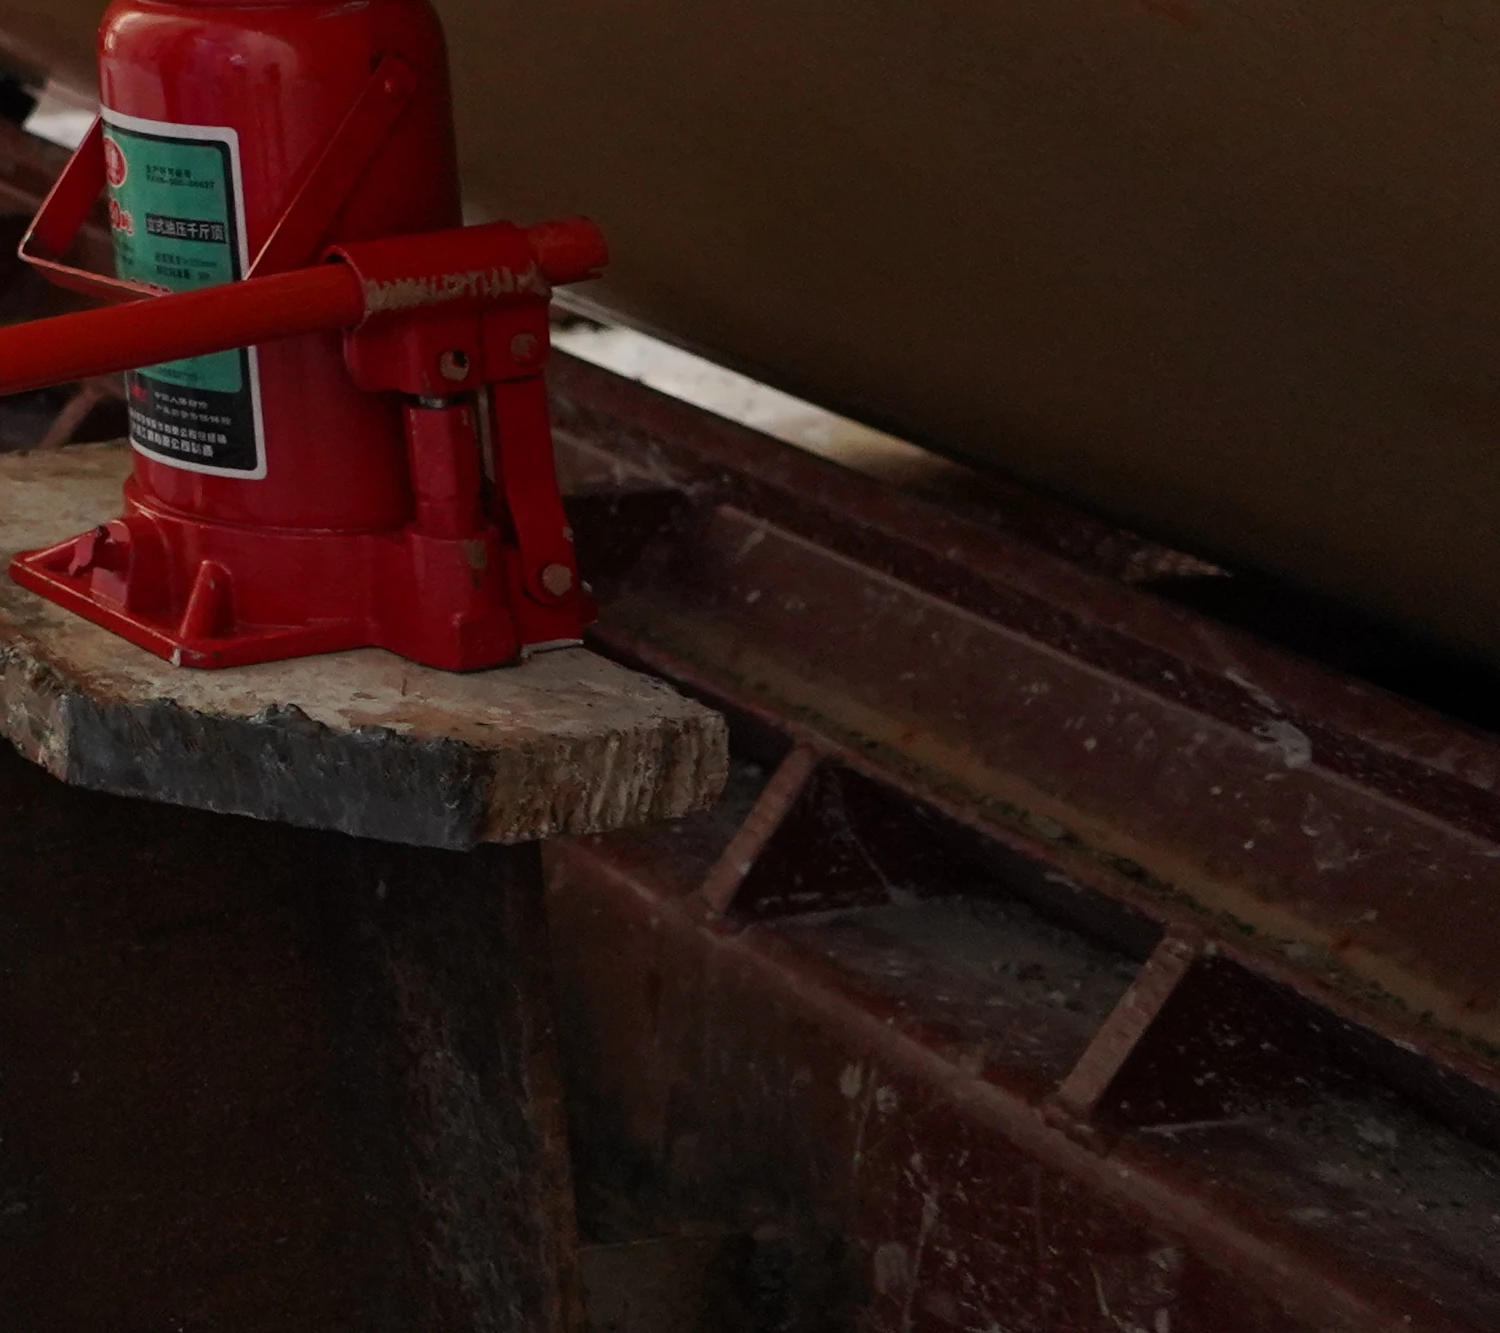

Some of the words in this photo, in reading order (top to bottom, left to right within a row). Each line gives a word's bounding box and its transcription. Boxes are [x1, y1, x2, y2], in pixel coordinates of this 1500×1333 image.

[147, 217, 225, 242] 立式油压千斤顶
